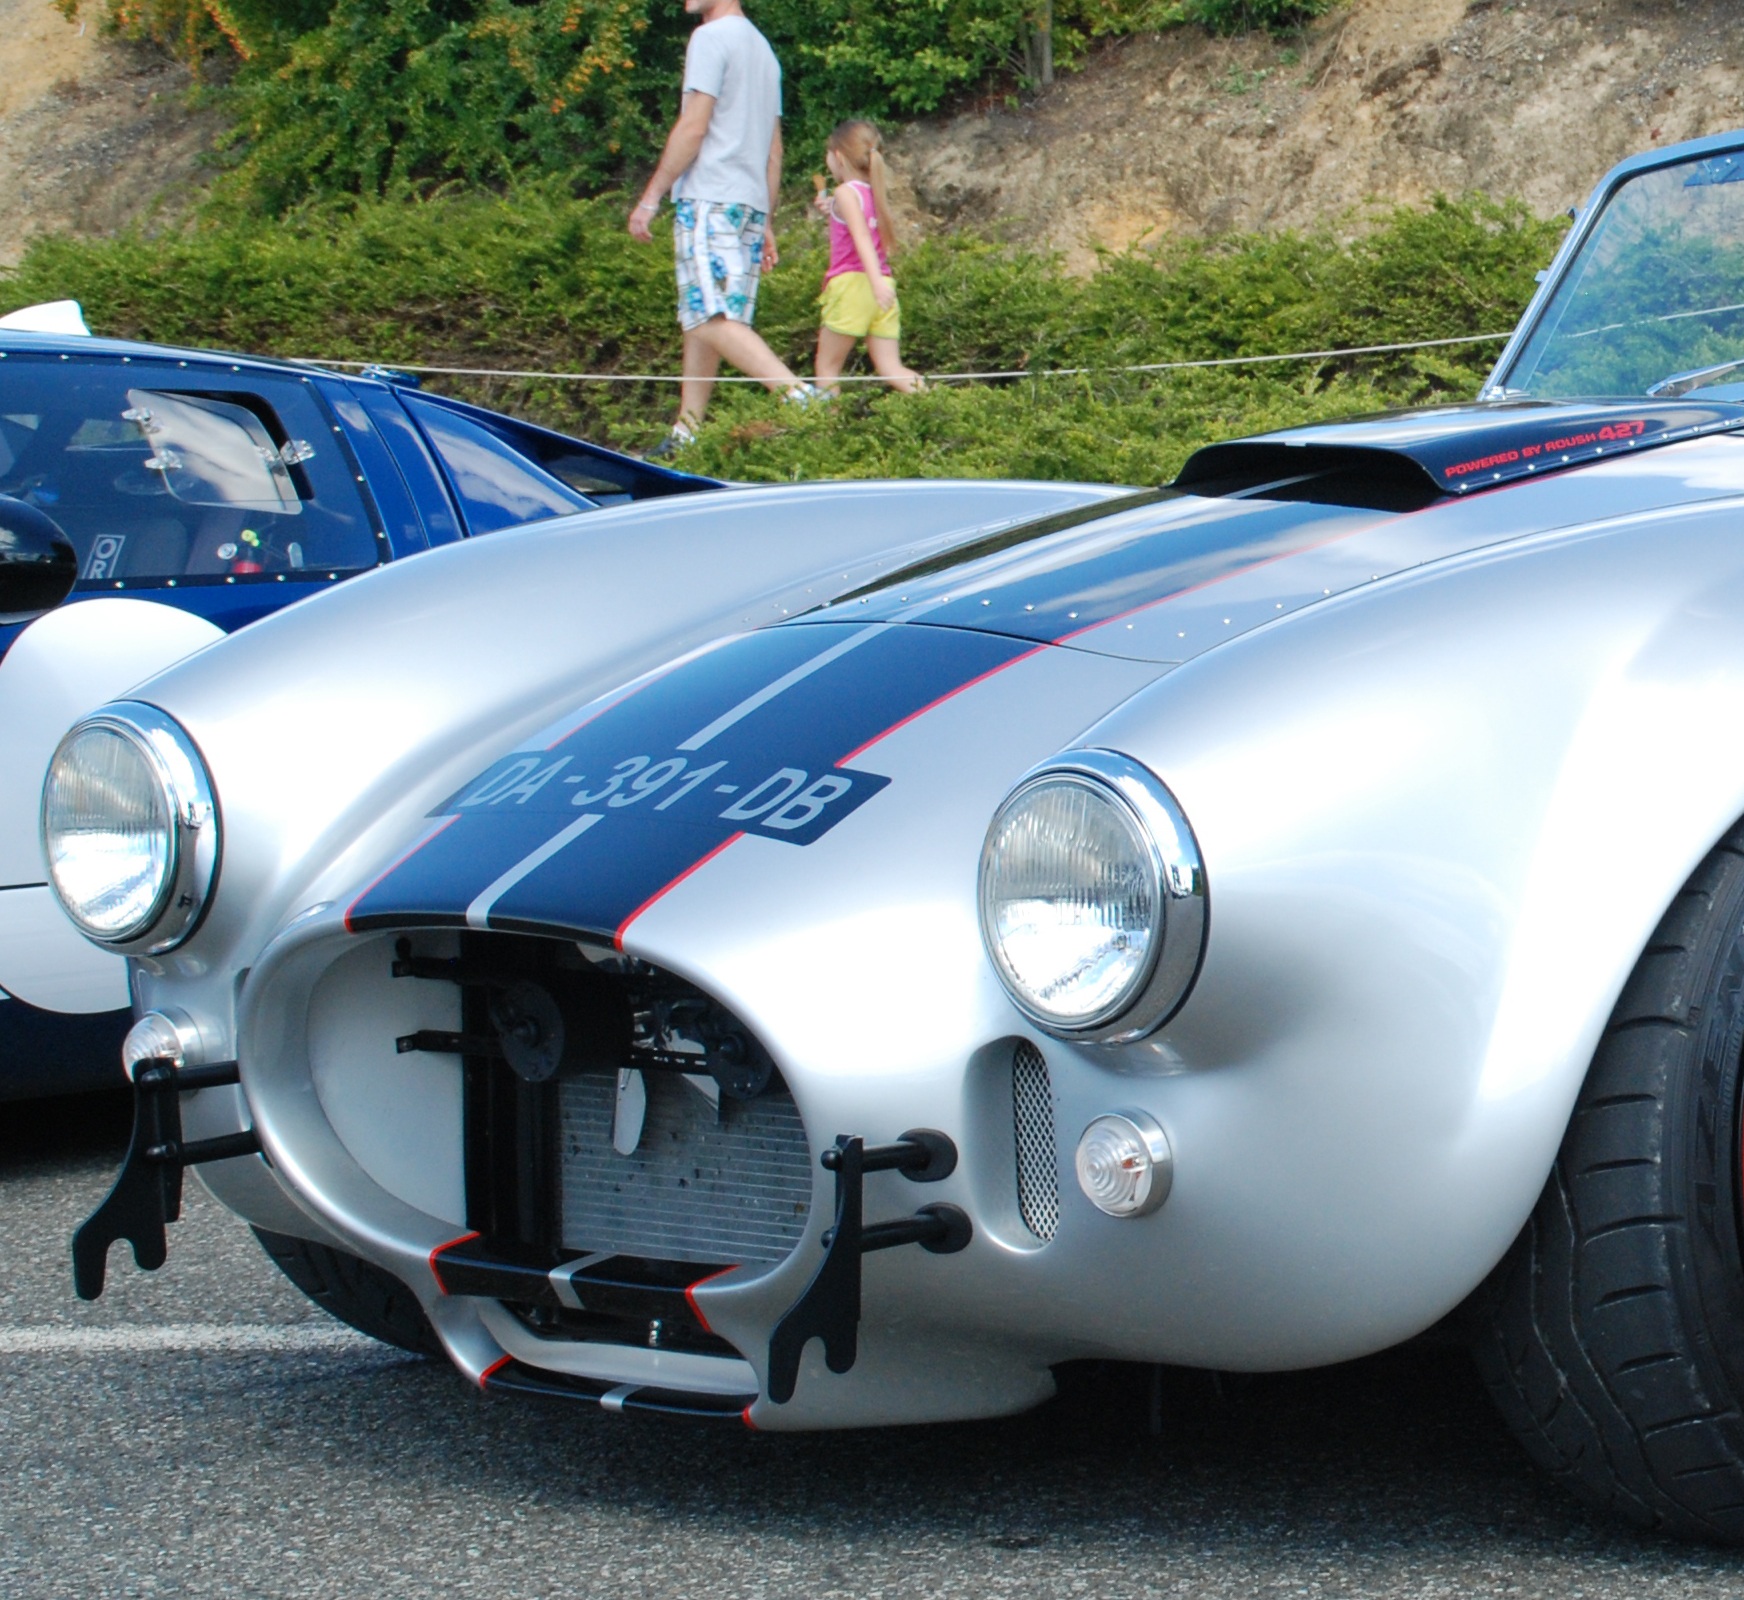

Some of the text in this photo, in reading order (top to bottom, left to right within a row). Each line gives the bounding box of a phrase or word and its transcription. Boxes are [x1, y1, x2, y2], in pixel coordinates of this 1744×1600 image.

[1444, 419, 1647, 478] POWERED BY ROUSH 427
